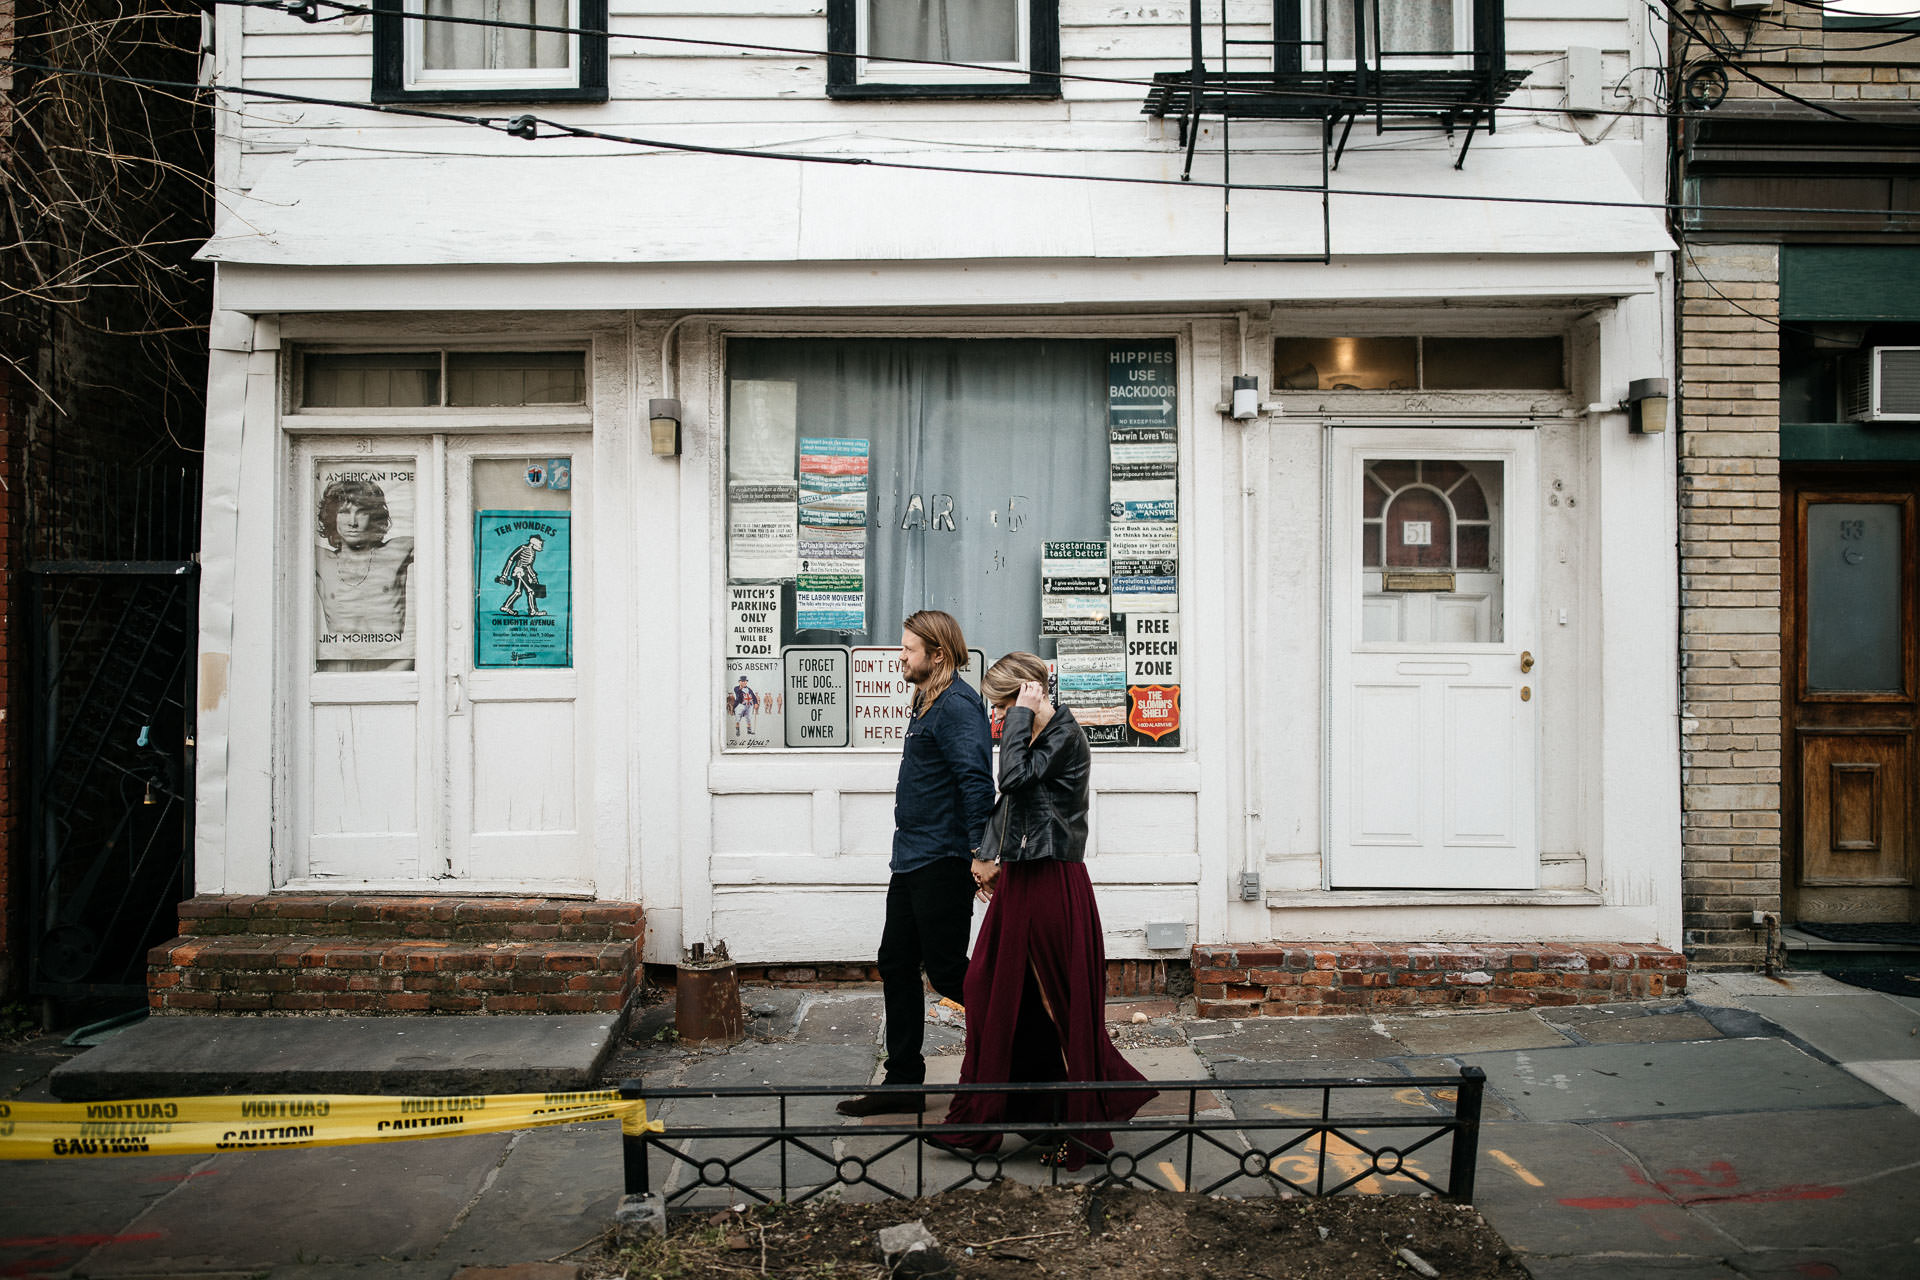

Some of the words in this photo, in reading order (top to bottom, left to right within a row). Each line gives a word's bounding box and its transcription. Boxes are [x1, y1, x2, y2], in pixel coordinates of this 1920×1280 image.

[1110, 352, 1174, 363] HIPPIES
[1129, 370, 1156, 381] USE
[1110, 386, 1176, 397] BACKDOOR
[1112, 432, 1137, 440] Darwin
[1139, 431, 1159, 440] Loves
[1160, 431, 1173, 440] You
[326, 472, 386, 481] AMERICAN
[1136, 502, 1153, 510] WAR
[1159, 502, 1174, 510] NOT
[494, 524, 512, 536] TEN
[513, 521, 557, 536] WONDERS
[1406, 523, 1428, 543] 51
[1050, 542, 1101, 552] Vegetarians
[1050, 550, 1072, 558] taste
[1075, 550, 1104, 558] better
[732, 589, 774, 599] WITCH'S
[832, 594, 864, 602] MOVEMENT
[731, 602, 776, 611] PARKING
[741, 613, 767, 623] ONLY
[1137, 620, 1169, 633] FREE
[319, 633, 337, 643] JIM
[343, 633, 402, 643] MORRISON
[736, 645, 771, 654] TOAD!
[1129, 641, 1178, 655] SPEECH
[745, 663, 778, 671] ABSENT?
[800, 659, 834, 671] FORGET
[855, 660, 883, 672] DON'T
[1135, 661, 1173, 675] ZONE
[791, 675, 808, 688] THE
[813, 675, 841, 688] DOG...
[856, 681, 891, 693] THINK
[897, 681, 911, 693] OF
[798, 692, 836, 704] BEWARE
[1148, 691, 1162, 699] THE
[1138, 700, 1173, 709] SLOMIN'S
[811, 709, 823, 721] OF
[856, 705, 912, 718] PARKING
[1142, 709, 1168, 718] SHIELD
[801, 725, 834, 738] OWNER
[865, 727, 903, 738] HERE
[746, 739, 769, 749] You?
[217, 1125, 315, 1149] CAUTION
[53, 1136, 150, 1155] CAUTION
